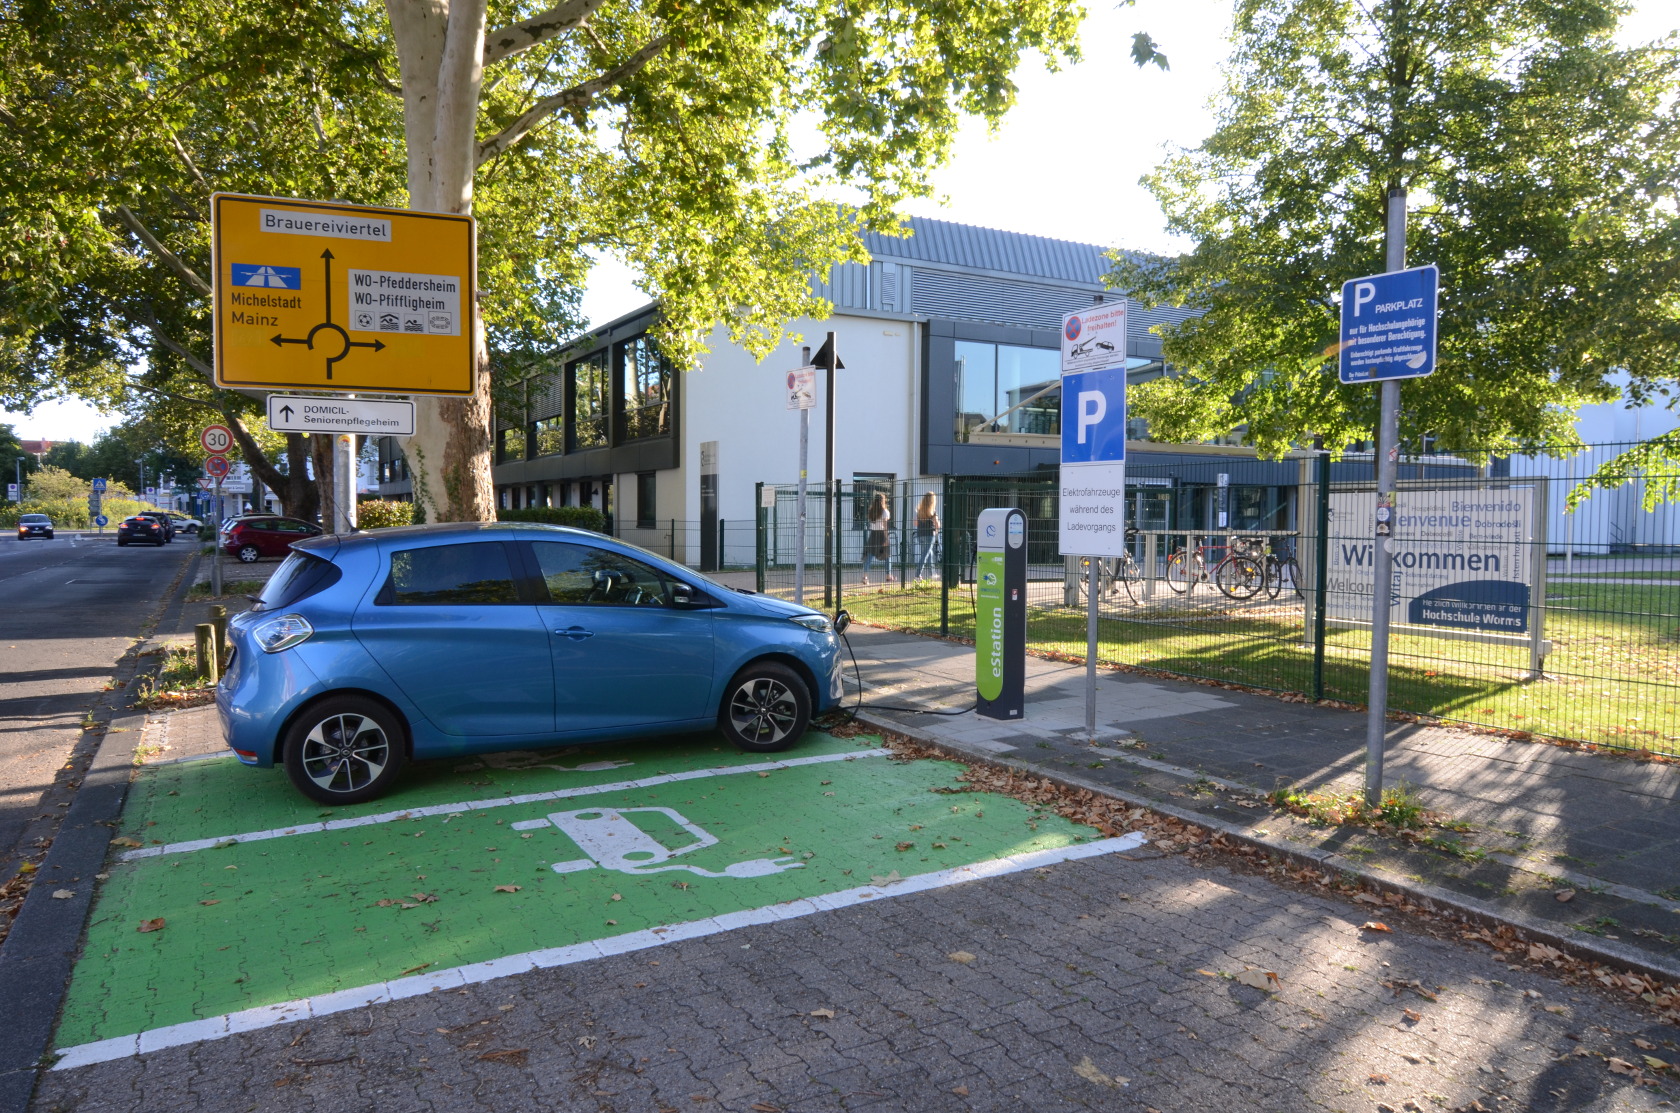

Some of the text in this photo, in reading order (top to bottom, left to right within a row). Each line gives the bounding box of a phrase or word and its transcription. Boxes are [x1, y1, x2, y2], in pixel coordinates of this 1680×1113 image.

[265, 214, 387, 237] Brauereiviertel
[354, 274, 456, 293] WO-Pfeddersheim
[231, 292, 302, 309] Michelstadt
[354, 292, 445, 312] WO-Pfiffligheim
[1354, 282, 1376, 317] P
[1376, 298, 1423, 314] PARKPLATZ
[231, 312, 279, 327] Mainz
[1082, 310, 1124, 324] Ladezone bitte
[1087, 320, 1116, 332] freihalten!
[1360, 324, 1368, 334] für
[304, 405, 350, 416] DOMICIL-
[1078, 390, 1107, 444] P
[304, 416, 400, 428] Seniorenpflegeheim
[208, 433, 227, 446] 30
[1062, 488, 1120, 498] Elektrofahrzeuge
[1070, 504, 1114, 514] während des
[1452, 500, 1521, 512] Bienvenido
[1067, 522, 1116, 534] Ladevorgangs
[1342, 544, 1500, 572] Wikommen
[1326, 578, 1374, 593] Welcom
[1422, 610, 1522, 626] Hochschule Worms
[990, 608, 1002, 678] eStation
